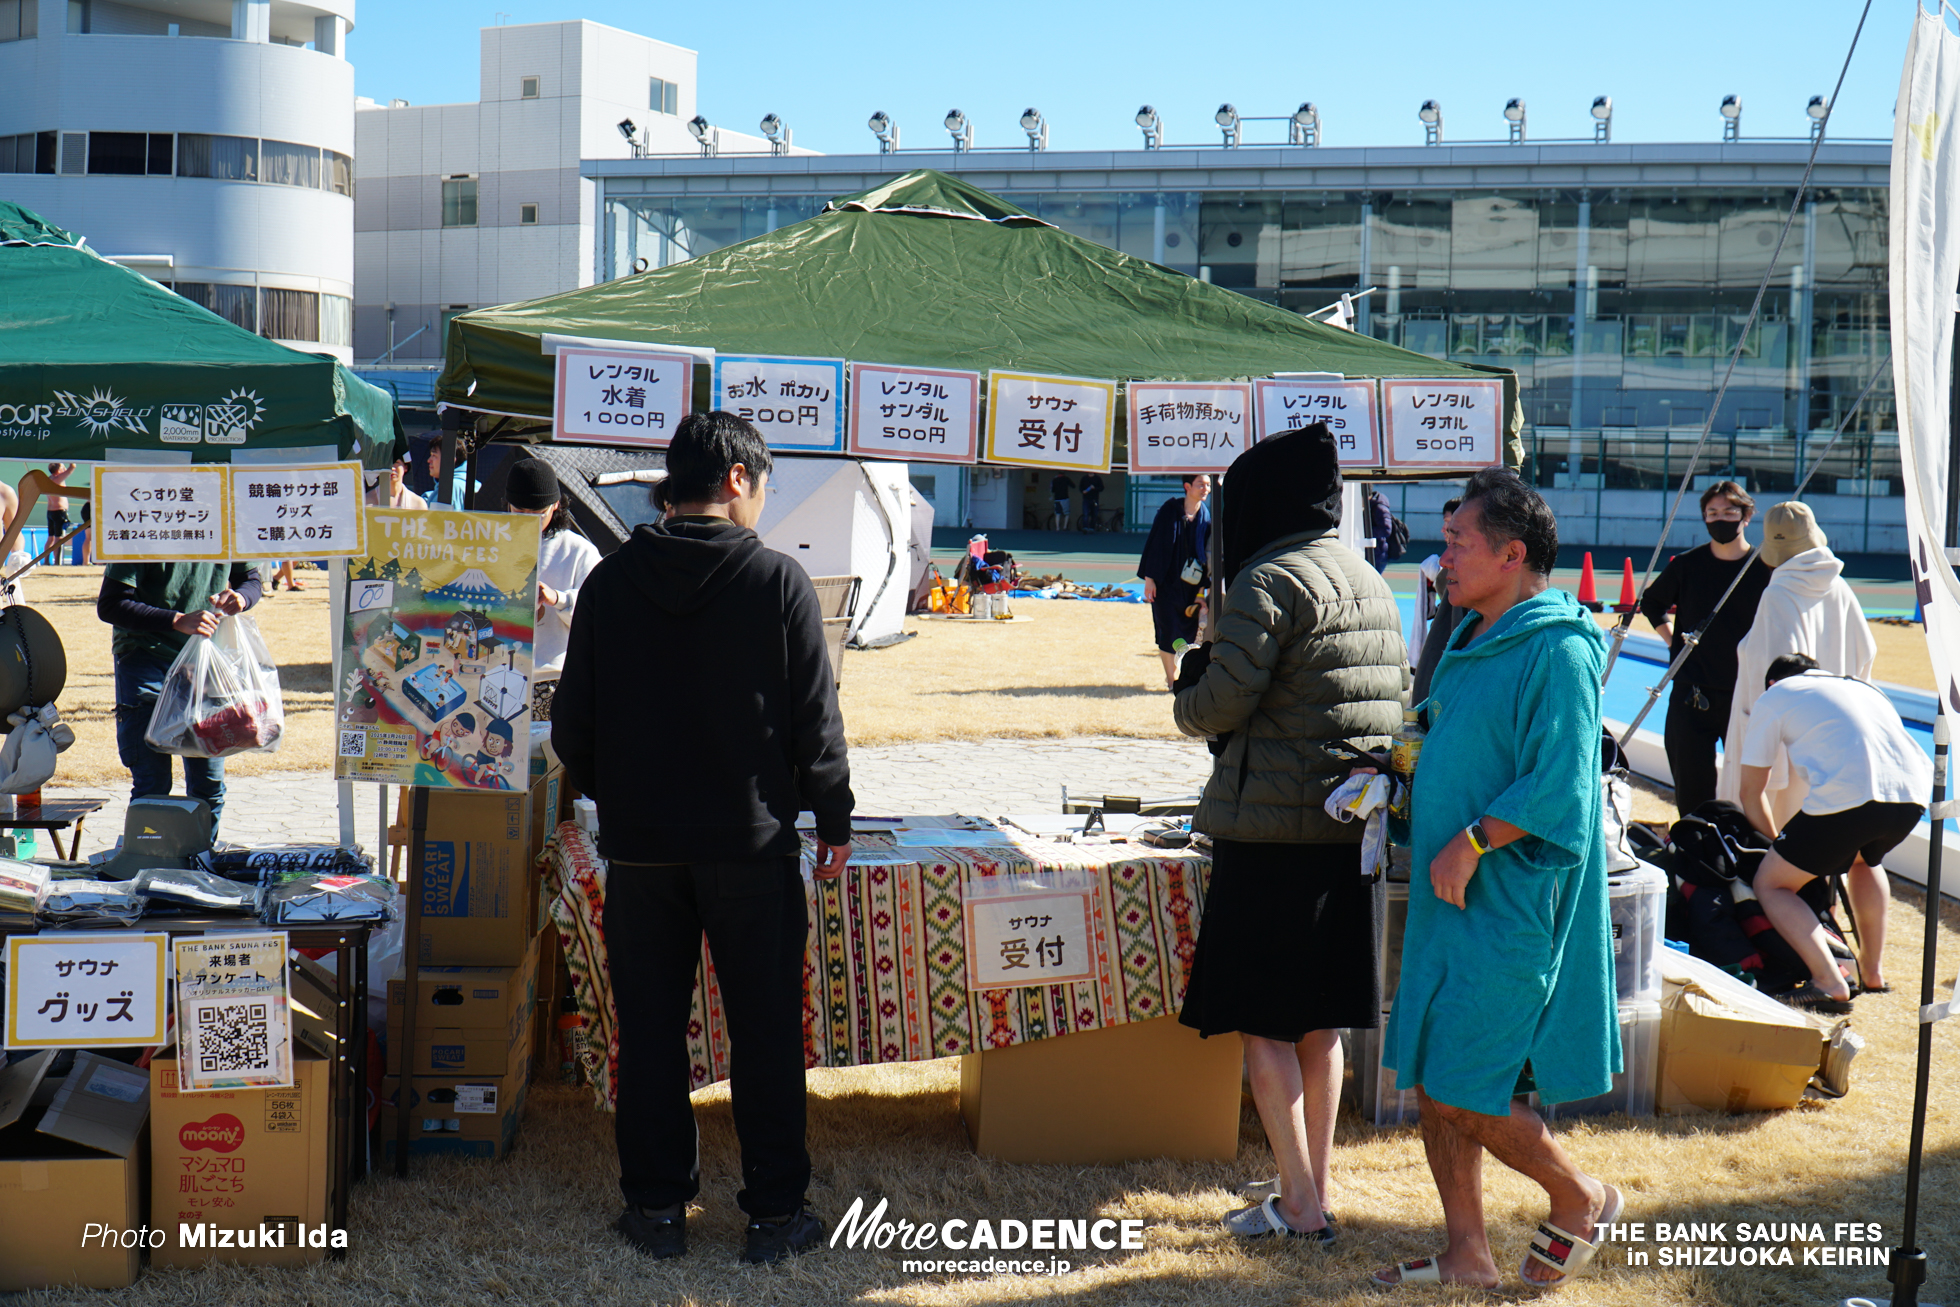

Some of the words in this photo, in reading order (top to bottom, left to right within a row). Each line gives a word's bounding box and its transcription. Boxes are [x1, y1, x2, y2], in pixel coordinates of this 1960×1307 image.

[588, 364, 660, 384] レンタル
[601, 384, 647, 409] 水着
[727, 375, 768, 399] お水
[779, 380, 830, 402] ポカリ
[880, 380, 949, 400] レンタル
[1026, 394, 1078, 412] サウナ
[1283, 394, 1348, 410] レンタル
[1411, 393, 1476, 411] レンタル
[583, 410, 665, 429] 1000円
[738, 405, 819, 427] 200円
[879, 402, 950, 423] サンダル
[1139, 401, 1242, 426] 手荷物預かり
[0, 425, 51, 440] style.jp
[163, 426, 199, 436] 2,000mm
[208, 421, 234, 437] UV
[1420, 416, 1469, 432] タオル
[882, 426, 946, 444] 500円
[1017, 418, 1083, 453] 受付
[1147, 431, 1235, 450] 500円/人
[1416, 436, 1475, 453] 500円
[130, 487, 194, 502] ぐっすり堂
[248, 481, 338, 498] 競輪サウナ部
[114, 509, 209, 524] ヘッドマッサージ
[276, 504, 313, 519] グッズ
[256, 525, 333, 541] ご購入の方
[374, 516, 433, 540] THE
[444, 520, 513, 542] BANK
[387, 542, 456, 562] SAUNA
[462, 545, 500, 564] FES
[424, 843, 438, 914] POCARI
[436, 850, 450, 915] SWEAT
[1008, 914, 1053, 931] サウナ
[182, 945, 199, 953] THE
[202, 943, 226, 952] BANK
[230, 942, 259, 950] SAUNA
[263, 940, 279, 948] FES
[1000, 935, 1065, 971] 受付
[55, 959, 119, 977] サウナ
[209, 953, 251, 968] 来場者
[195, 970, 265, 985] アンケート
[37, 990, 133, 1022] グッズ
[271, 1101, 295, 1110] 56枚
[270, 1111, 295, 1120] 4袋入
[182, 1126, 241, 1145] moony
[179, 1156, 245, 1173] マシュマロ
[178, 1174, 245, 1193] 肌ごこち
[178, 1211, 203, 1220] 女の子
[1538, 1225, 1573, 1247] TOMMY
